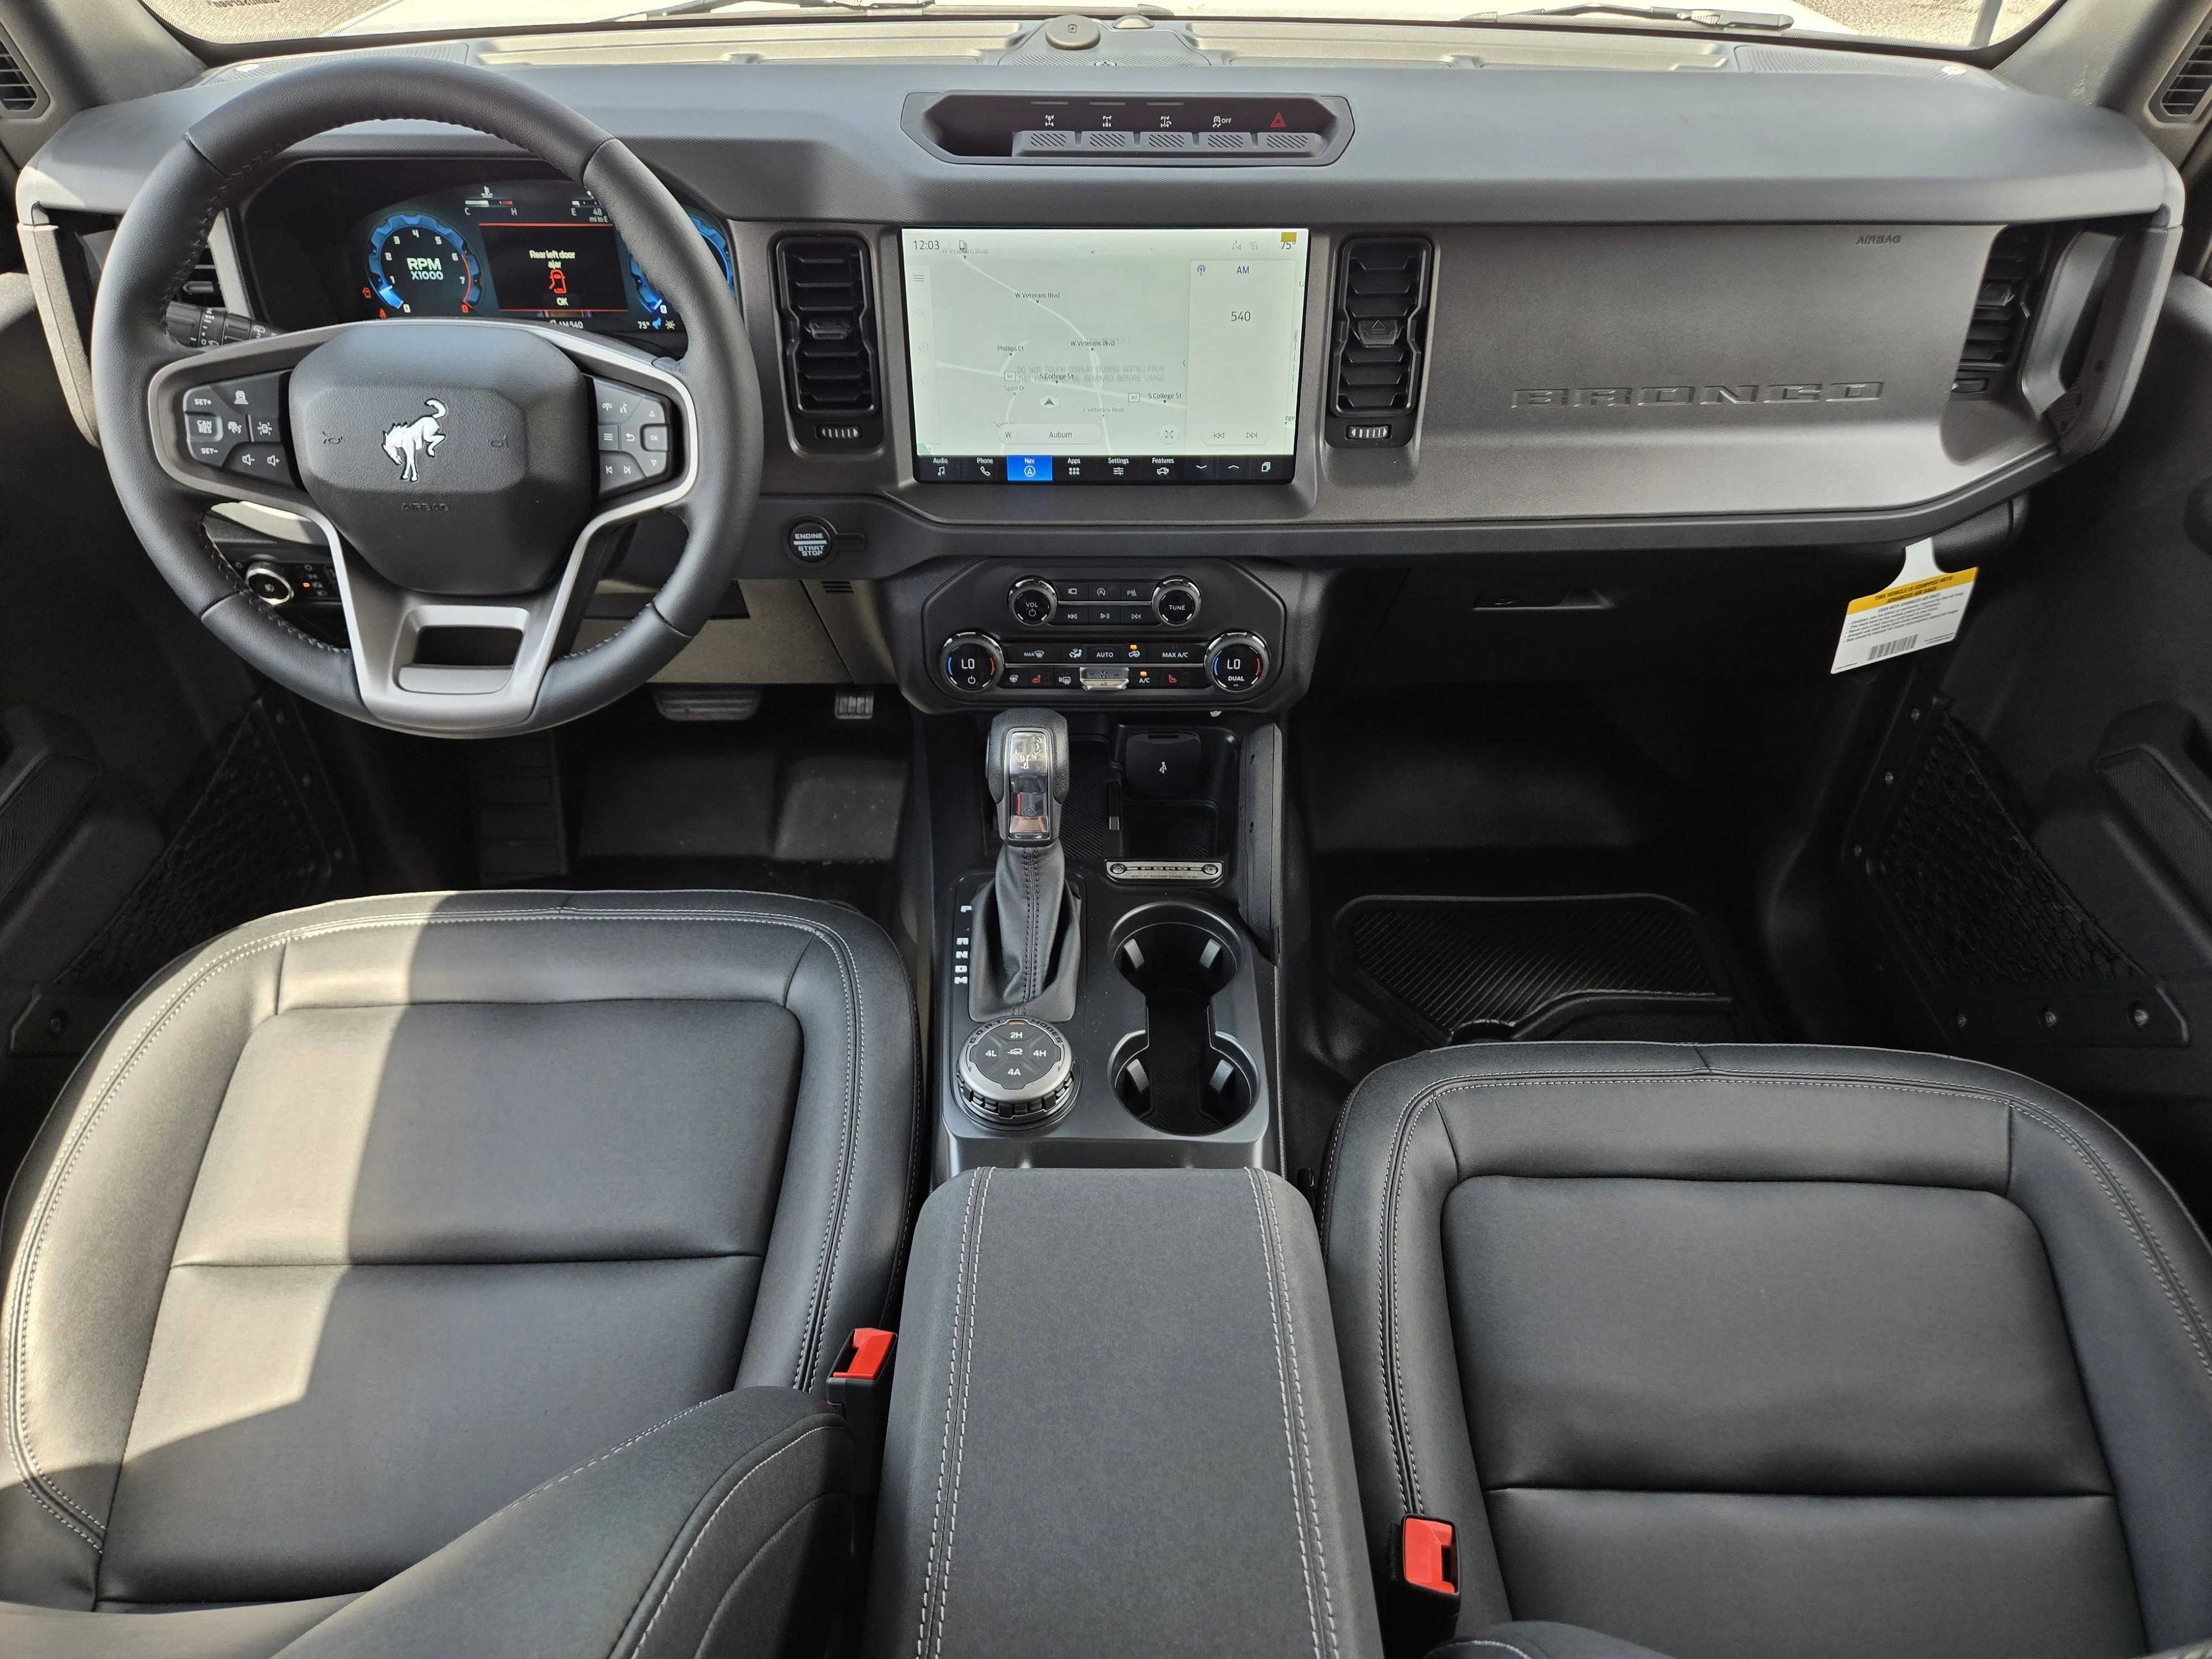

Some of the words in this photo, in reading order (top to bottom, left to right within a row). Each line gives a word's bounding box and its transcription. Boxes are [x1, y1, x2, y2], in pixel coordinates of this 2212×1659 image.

[412, 229, 419, 238] 4
[435, 236, 442, 244] 5
[1855, 234, 1901, 246] AIRBAG
[914, 241, 940, 250] 12:03
[385, 252, 392, 260] 2
[529, 250, 546, 259] Rear
[546, 250, 559, 259] left
[559, 250, 576, 259] door
[406, 258, 442, 270] RPM
[548, 260, 561, 269] ajar
[390, 275, 395, 284] 1
[410, 270, 444, 280] X1000
[556, 297, 568, 306] OK
[403, 304, 411, 313] 0
[1231, 311, 1251, 321] 540
[1511, 381, 1885, 408] BRONCO
[961, 659, 975, 669] LO
[1227, 659, 1240, 669] LO
[1030, 1019, 1063, 1044] MODES
